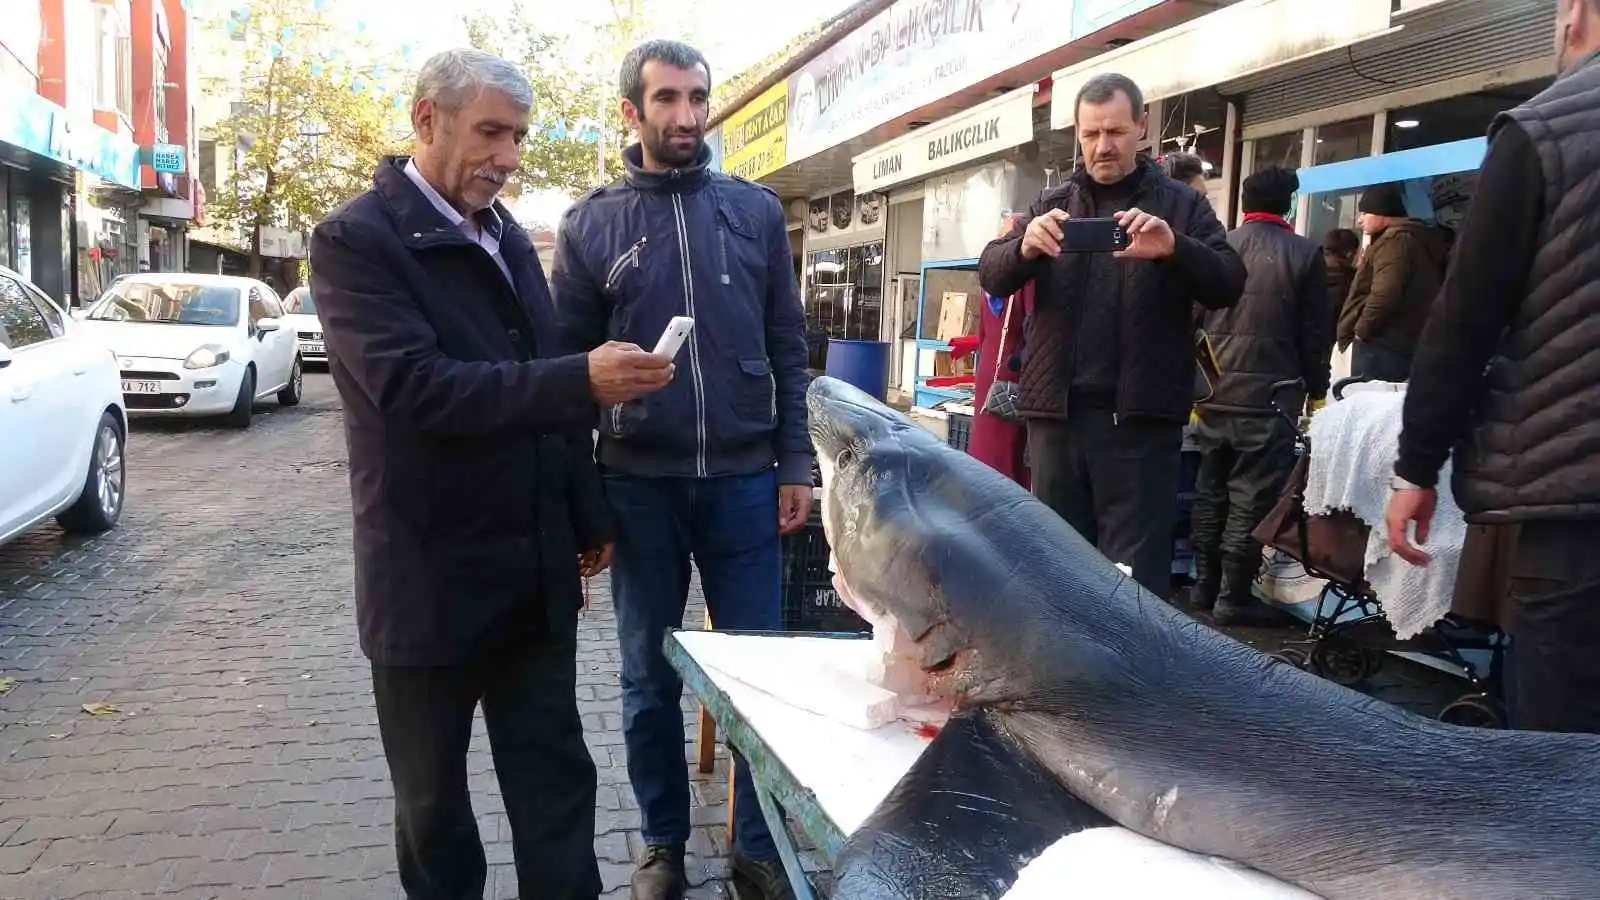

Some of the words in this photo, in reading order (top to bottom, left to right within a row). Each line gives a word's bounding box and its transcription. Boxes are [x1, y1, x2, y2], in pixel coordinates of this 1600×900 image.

[769, 101, 785, 127] CAR
[873, 153, 902, 180] LİMAN
[138, 382, 156, 392] 712
